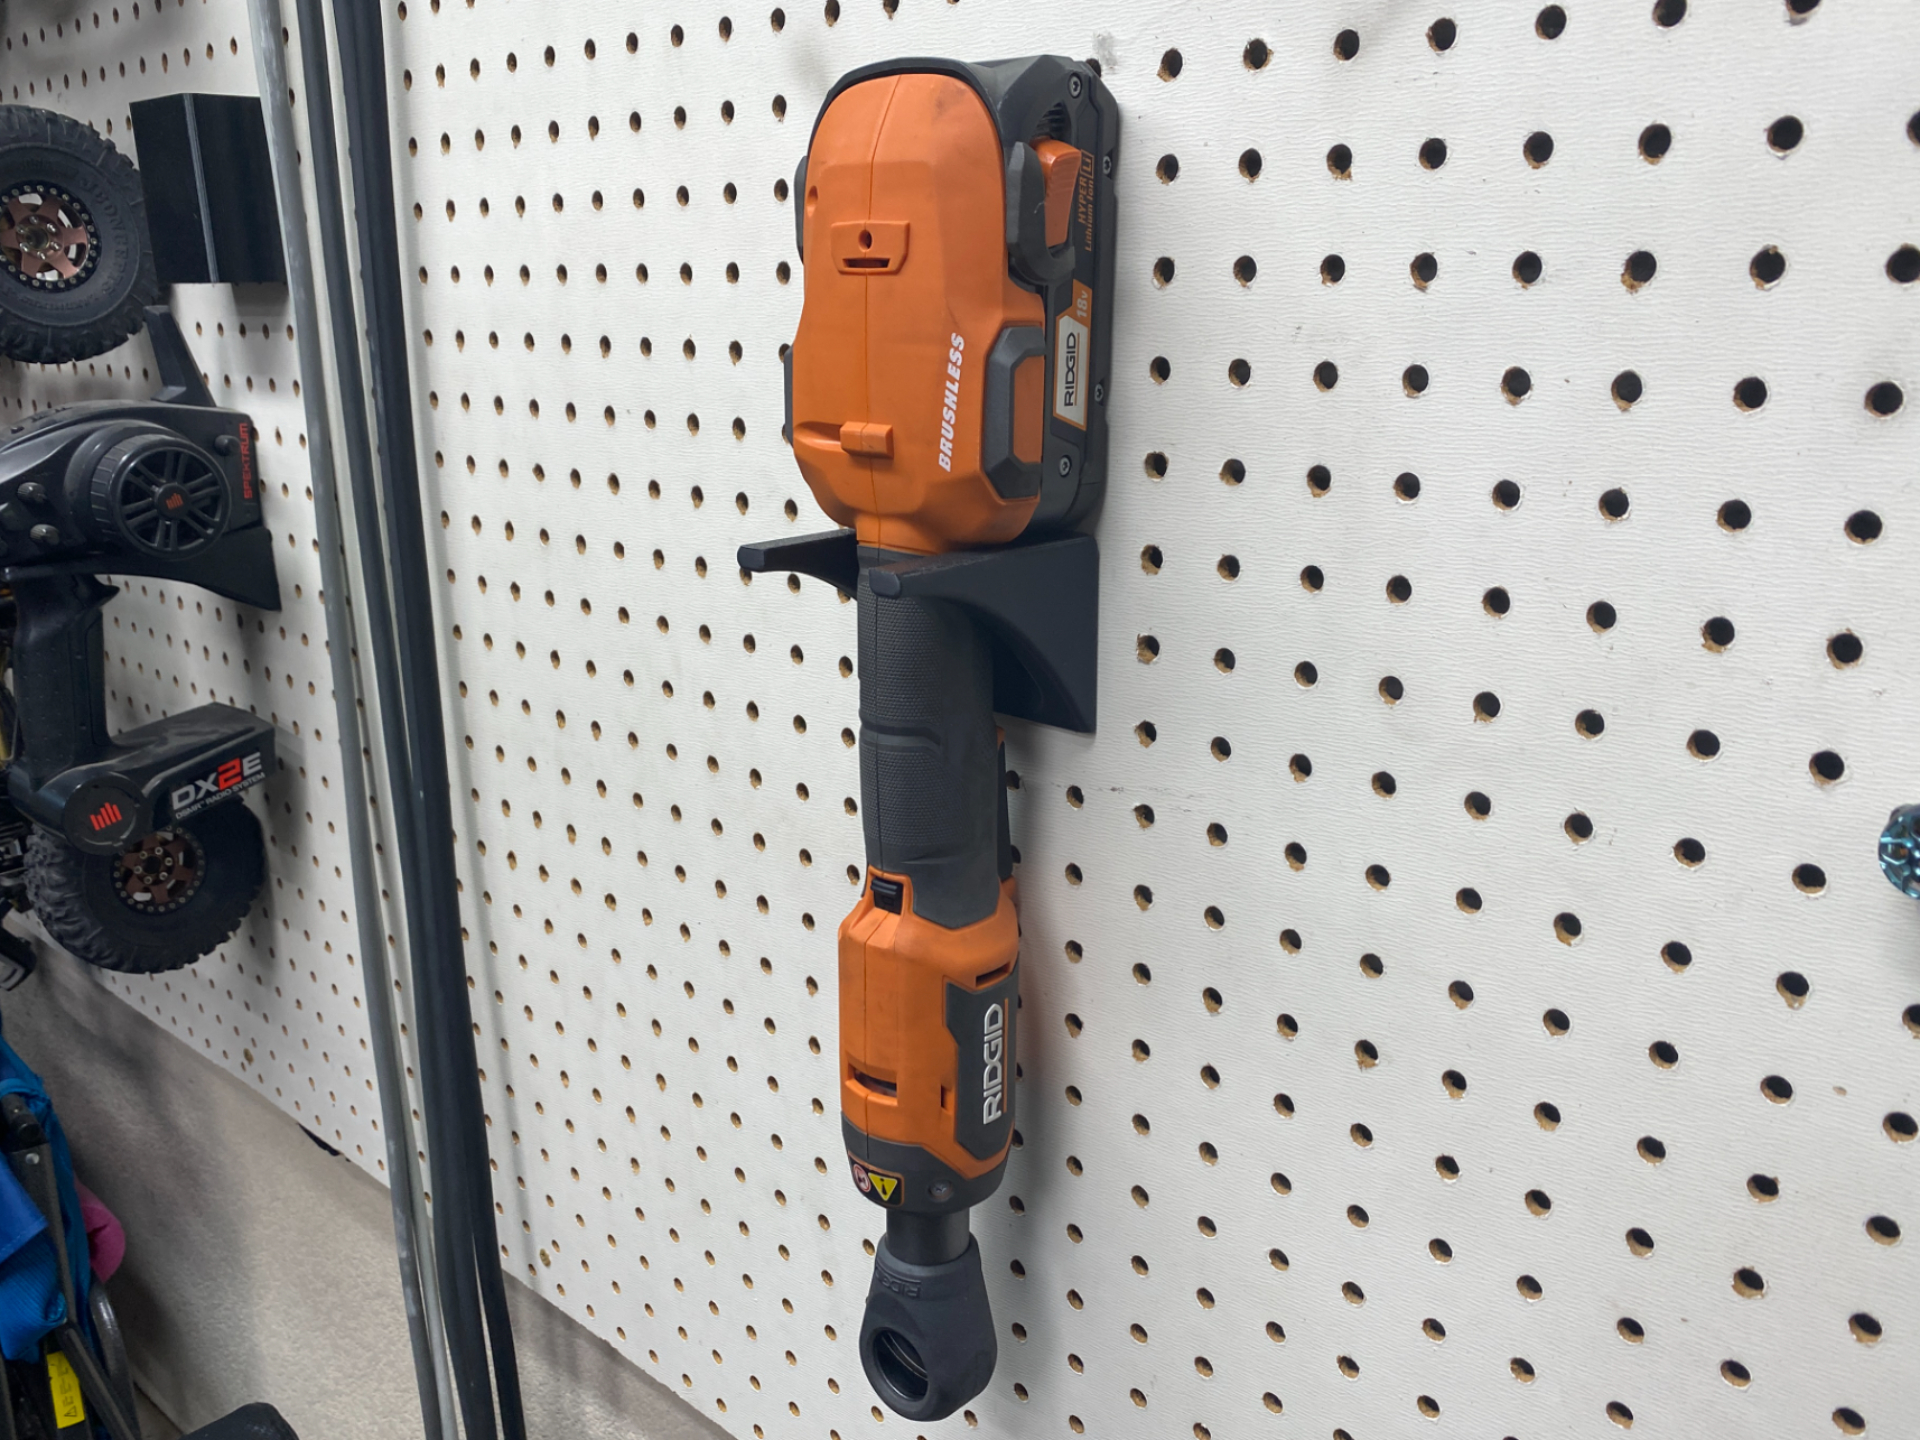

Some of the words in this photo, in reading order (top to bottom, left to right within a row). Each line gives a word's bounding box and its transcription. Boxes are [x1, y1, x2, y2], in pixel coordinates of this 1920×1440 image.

[1078, 176, 1088, 224] HYPER
[1085, 203, 1094, 252] Lithium
[938, 332, 965, 473] BRUSHLESS
[1064, 331, 1077, 407] RIDGID
[239, 422, 253, 499] SPEKTRUM
[171, 751, 262, 810] DX2E
[206, 788, 232, 806] RADIO
[232, 771, 266, 792] SYSTEM
[983, 1003, 1003, 1125] RIDGID
